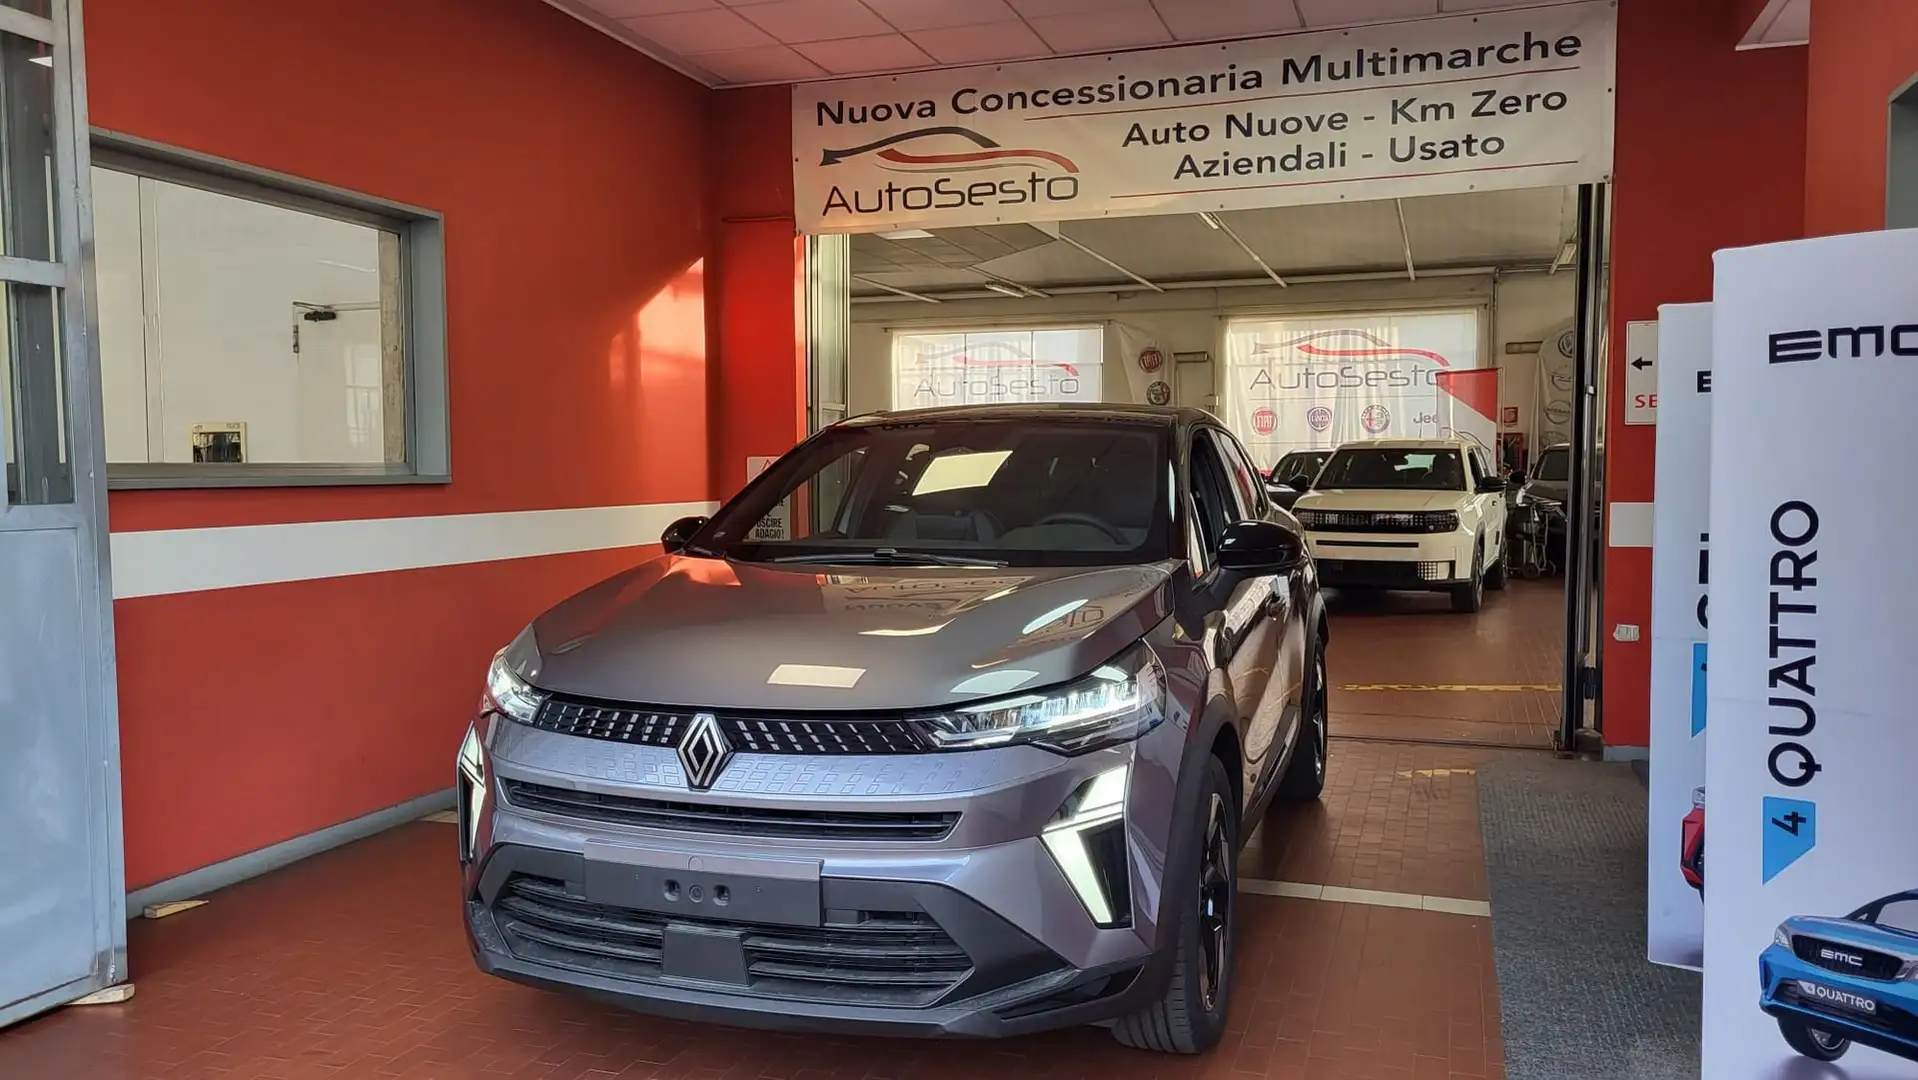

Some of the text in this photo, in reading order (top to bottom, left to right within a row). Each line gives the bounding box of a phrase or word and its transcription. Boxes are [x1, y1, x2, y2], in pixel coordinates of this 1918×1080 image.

[817, 31, 1582, 126] Nuova Concessionaria Multimarche
[1122, 122, 1210, 147] Auto
[1225, 112, 1349, 139] Nuove
[1391, 97, 1455, 125] Km
[1471, 90, 1567, 117] Zero
[1173, 141, 1346, 179] Aziendali
[1390, 134, 1504, 162] Usato
[822, 172, 1079, 216] AutoSesto
[914, 374, 1079, 397] AutoSesto
[1250, 364, 1446, 390] AutoSesto
[1635, 394, 1658, 409] SE
[1413, 411, 1437, 424] Jee
[755, 529, 784, 539] ADAGIO!
[1767, 500, 1822, 837] 4 QUATTRO
[1816, 986, 1875, 1011] QUATTRO
